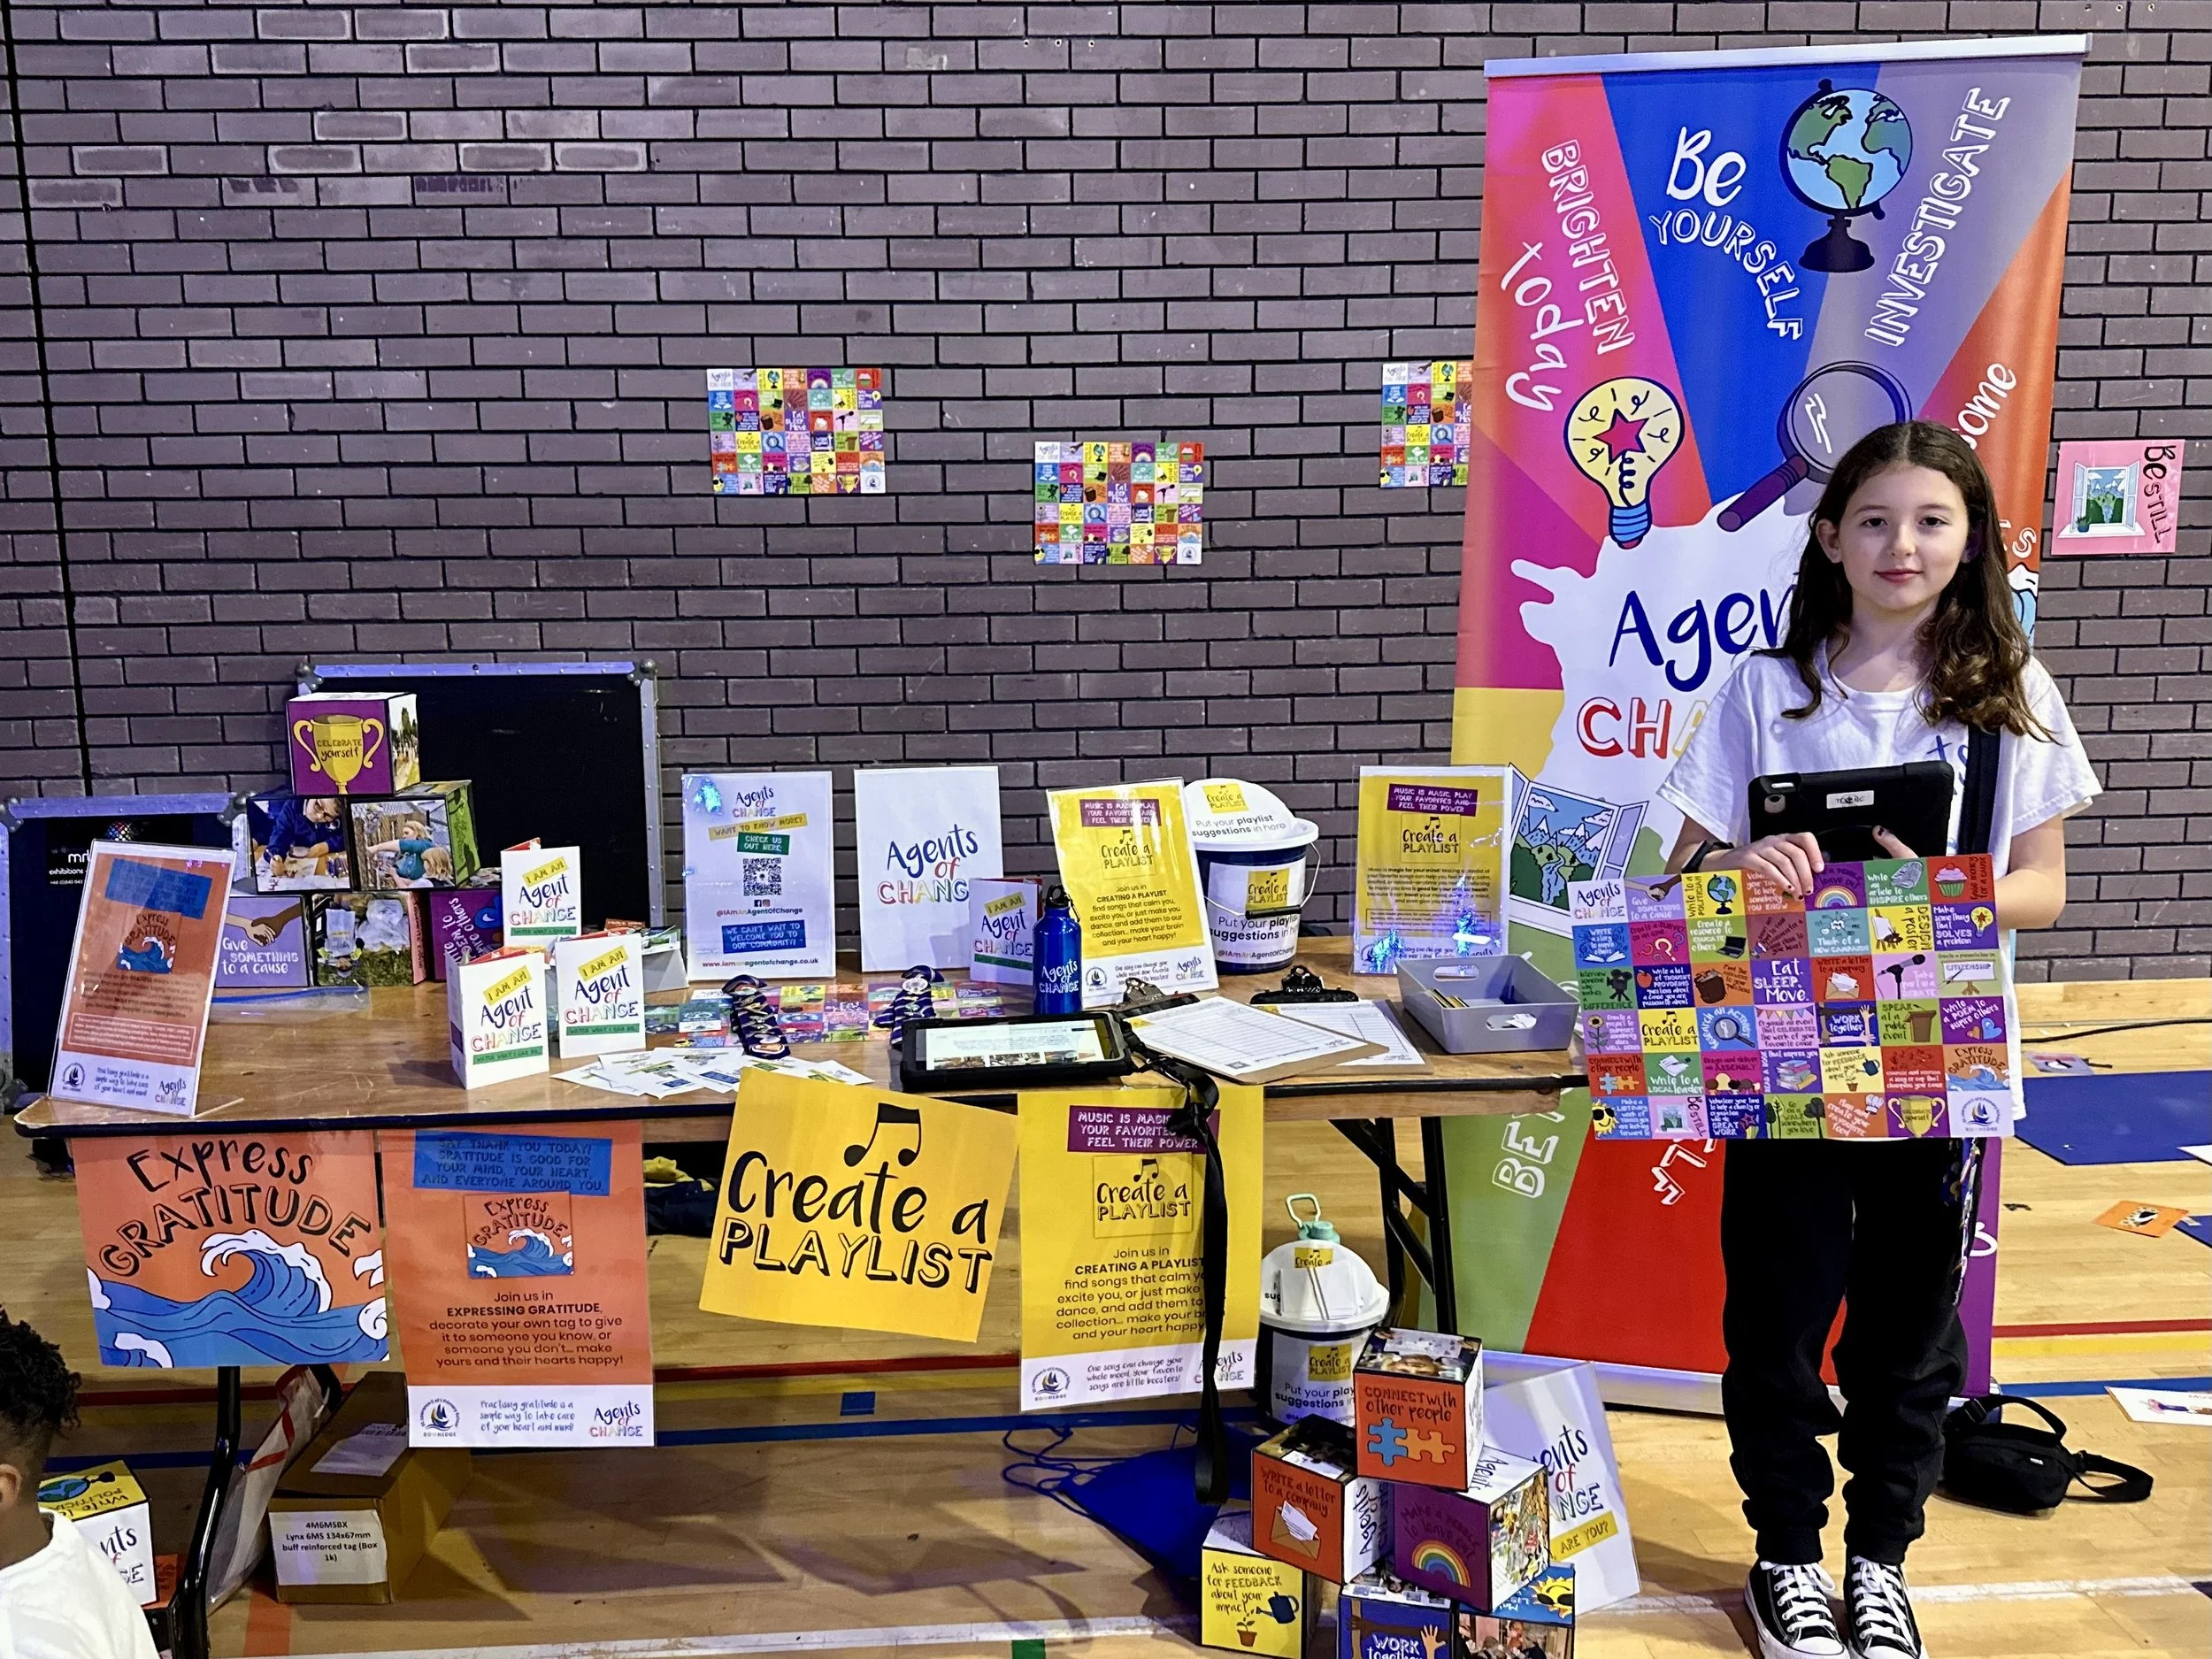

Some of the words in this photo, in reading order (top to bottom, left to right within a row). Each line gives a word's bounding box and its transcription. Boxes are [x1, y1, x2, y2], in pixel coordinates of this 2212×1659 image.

[1665, 125, 1747, 208] Be
[1863, 86, 2012, 349] INVESTIGATE
[1541, 139, 1635, 355] BRIGHTEN
[1647, 207, 1804, 342] YOURSELF
[2143, 445, 2177, 480] Be
[2144, 481, 2172, 544] STILL
[1609, 589, 1800, 692] Agen
[713, 826, 736, 836] WANT
[754, 821, 774, 830] KNOW
[780, 818, 803, 828] MORE?
[1402, 828, 1444, 843] Create
[1449, 833, 1456, 842] a
[887, 824, 979, 879] Agents
[1101, 842, 1139, 858] Create
[1143, 844, 1150, 854] a
[1403, 843, 1459, 853] PLAYLIST
[934, 856, 961, 879] of
[518, 873, 570, 908] Agent
[877, 879, 970, 905] CHANG
[1096, 893, 1130, 902] CREATING
[1139, 890, 1167, 899] PLAYLIST
[1248, 894, 1287, 904] PLAYLIST
[1577, 883, 1620, 907] Agents
[545, 895, 561, 909] of
[509, 906, 576, 926] CHANGE
[981, 909, 1026, 939] Agent
[1218, 916, 1237, 927] Put
[1241, 918, 1266, 929] your
[1916, 906, 1933, 950] DESIGN
[222, 937, 248, 951] Give
[974, 940, 1033, 956] CHANGE
[231, 953, 298, 963] SOMETHING
[702, 958, 818, 968] www.iamanagentofchange.co.uk
[1041, 958, 1078, 982] Agents
[1771, 958, 1803, 976] Eat.
[575, 964, 630, 1003] Agent
[1039, 979, 1079, 995] CHANGE
[1754, 976, 1801, 989] SLEEP.
[604, 988, 622, 1004] of
[1766, 989, 1809, 1002] Move.
[480, 986, 534, 1028] Agent
[563, 1002, 639, 1025] CHANGE
[1882, 1002, 1911, 1011] SPEAK
[509, 1010, 525, 1027] of
[1832, 1015, 1862, 1024] WORK
[471, 1022, 542, 1052] CHANGE
[1642, 1021, 1682, 1036] Create
[1688, 1025, 1695, 1033] a
[1644, 1035, 1697, 1046] PLAYLIST
[1955, 1046, 1993, 1057] Express
[1947, 1056, 2007, 1074] GRATITUDE
[1673, 1083, 1703, 1094] leader
[1087, 1137, 1115, 1147] FEEL
[1121, 1138, 1153, 1148] THEIR
[1159, 1139, 1198, 1148] POWER
[127, 1140, 312, 1192] Express
[727, 1150, 927, 1234] Create
[952, 1198, 989, 1244] a
[1096, 1179, 1165, 1204] Create
[1175, 1183, 1187, 1200] a
[484, 1196, 549, 1215] Express
[1098, 1201, 1191, 1221] PLAYLIST
[99, 1183, 372, 1277] GRATITUDE
[472, 1212, 568, 1246] GRATITUDE
[718, 1217, 993, 1294] PLAYLIST
[1114, 1248, 1138, 1259] Join
[1159, 1247, 1170, 1256] in
[1075, 1263, 1137, 1275] CREATING
[1064, 1279, 1088, 1289] find
[1092, 1277, 1128, 1289] songs
[1131, 1274, 1156, 1284] that
[1159, 1272, 1190, 1283] calm
[494, 1292, 520, 1302] Join
[524, 1293, 539, 1302] us
[541, 1291, 554, 1301] in
[1057, 1294, 1094, 1303] excite
[1097, 1292, 1123, 1302] you,
[1125, 1289, 1138, 1299] or
[1141, 1287, 1163, 1300] just
[1166, 1286, 1200, 1295] make
[447, 1306, 525, 1317] EXPRESSING
[528, 1303, 603, 1315] GRATITUDE,
[1056, 1307, 1098, 1317] dance,
[1102, 1302, 1125, 1313] and
[1129, 1301, 1153, 1310] add
[1156, 1300, 1187, 1309] them
[1191, 1297, 1202, 1307] to
[429, 1320, 488, 1330] decorate
[491, 1320, 519, 1331] your
[524, 1319, 550, 1328] own
[554, 1318, 575, 1329] tag
[580, 1317, 592, 1327] to
[595, 1317, 623, 1328] give
[1072, 1330, 1097, 1340] and
[1101, 1329, 1128, 1340] your
[1131, 1325, 1163, 1335] heart
[442, 1333, 450, 1342] it
[454, 1333, 466, 1341] to
[470, 1333, 529, 1342] someone
[533, 1332, 556, 1343] you
[559, 1332, 595, 1341] know,
[598, 1332, 611, 1340] or
[436, 1357, 472, 1368] yours
[474, 1356, 499, 1366] and
[503, 1356, 531, 1365] their
[534, 1356, 575, 1365] hearts
[579, 1356, 623, 1367] happy!
[1364, 1386, 1424, 1402] CONNECT
[1425, 1390, 1457, 1409] with
[595, 1400, 641, 1425] Agents
[1365, 1400, 1404, 1417] other
[1409, 1404, 1452, 1422] people
[588, 1425, 643, 1438] CHANGE
[1555, 1463, 1576, 1493] of
[1560, 1537, 1580, 1554] ARE
[1585, 1521, 1609, 1541] YOU?
[1211, 1563, 1230, 1574] Ask
[1233, 1564, 1271, 1576] someone
[1208, 1575, 1223, 1586] for
[1225, 1576, 1281, 1587] FEEDBACK
[1211, 1589, 1238, 1600] about
[1242, 1591, 1263, 1602] your
[1216, 1601, 1248, 1614] impact
[1372, 1634, 1420, 1655] WORK
